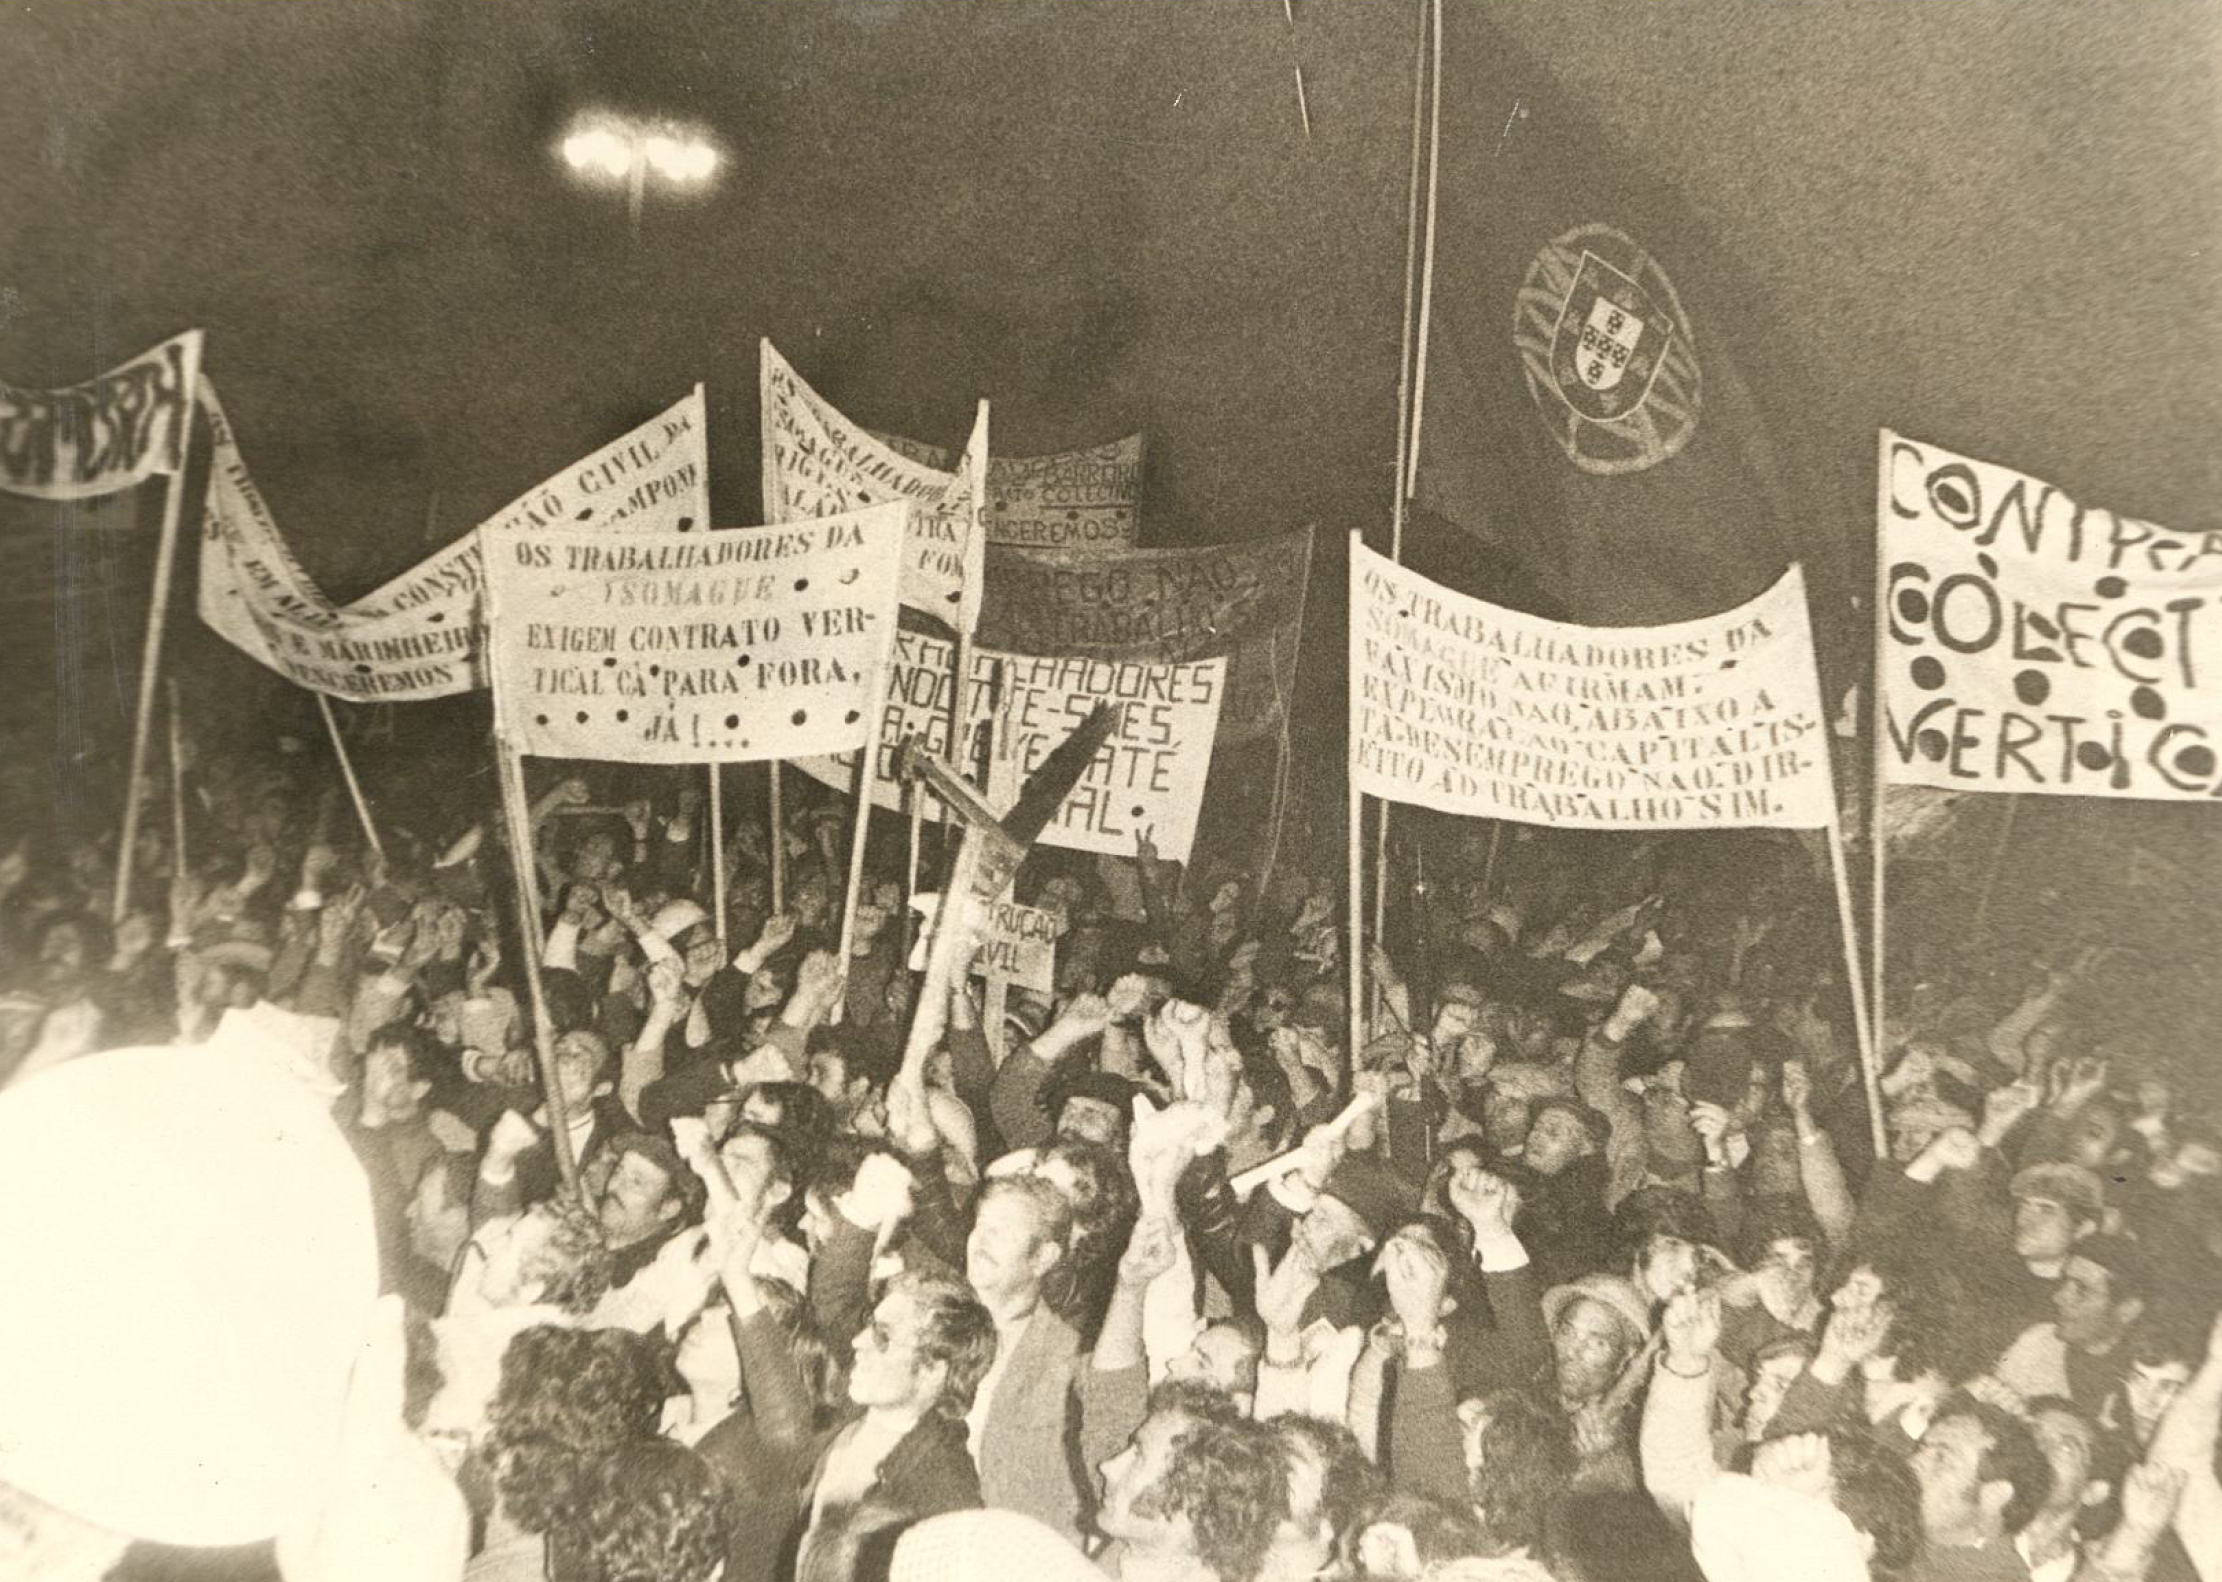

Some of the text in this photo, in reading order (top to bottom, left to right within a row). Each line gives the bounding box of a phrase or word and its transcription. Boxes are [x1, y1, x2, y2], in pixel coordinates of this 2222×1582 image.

[577, 440, 660, 495] CIVIL
[516, 522, 866, 573] OS TRABALHADORES DA
[526, 606, 876, 653] EXIGEM CONTRATO VER-
[1363, 569, 1773, 672] OS TRABALHADORES DA
[533, 666, 604, 695] TICAL
[662, 667, 740, 697] PARA
[1586, 697, 1740, 733] ABAIXO
[1752, 688, 1777, 714] A
[1490, 779, 1683, 823] TRABALHO
